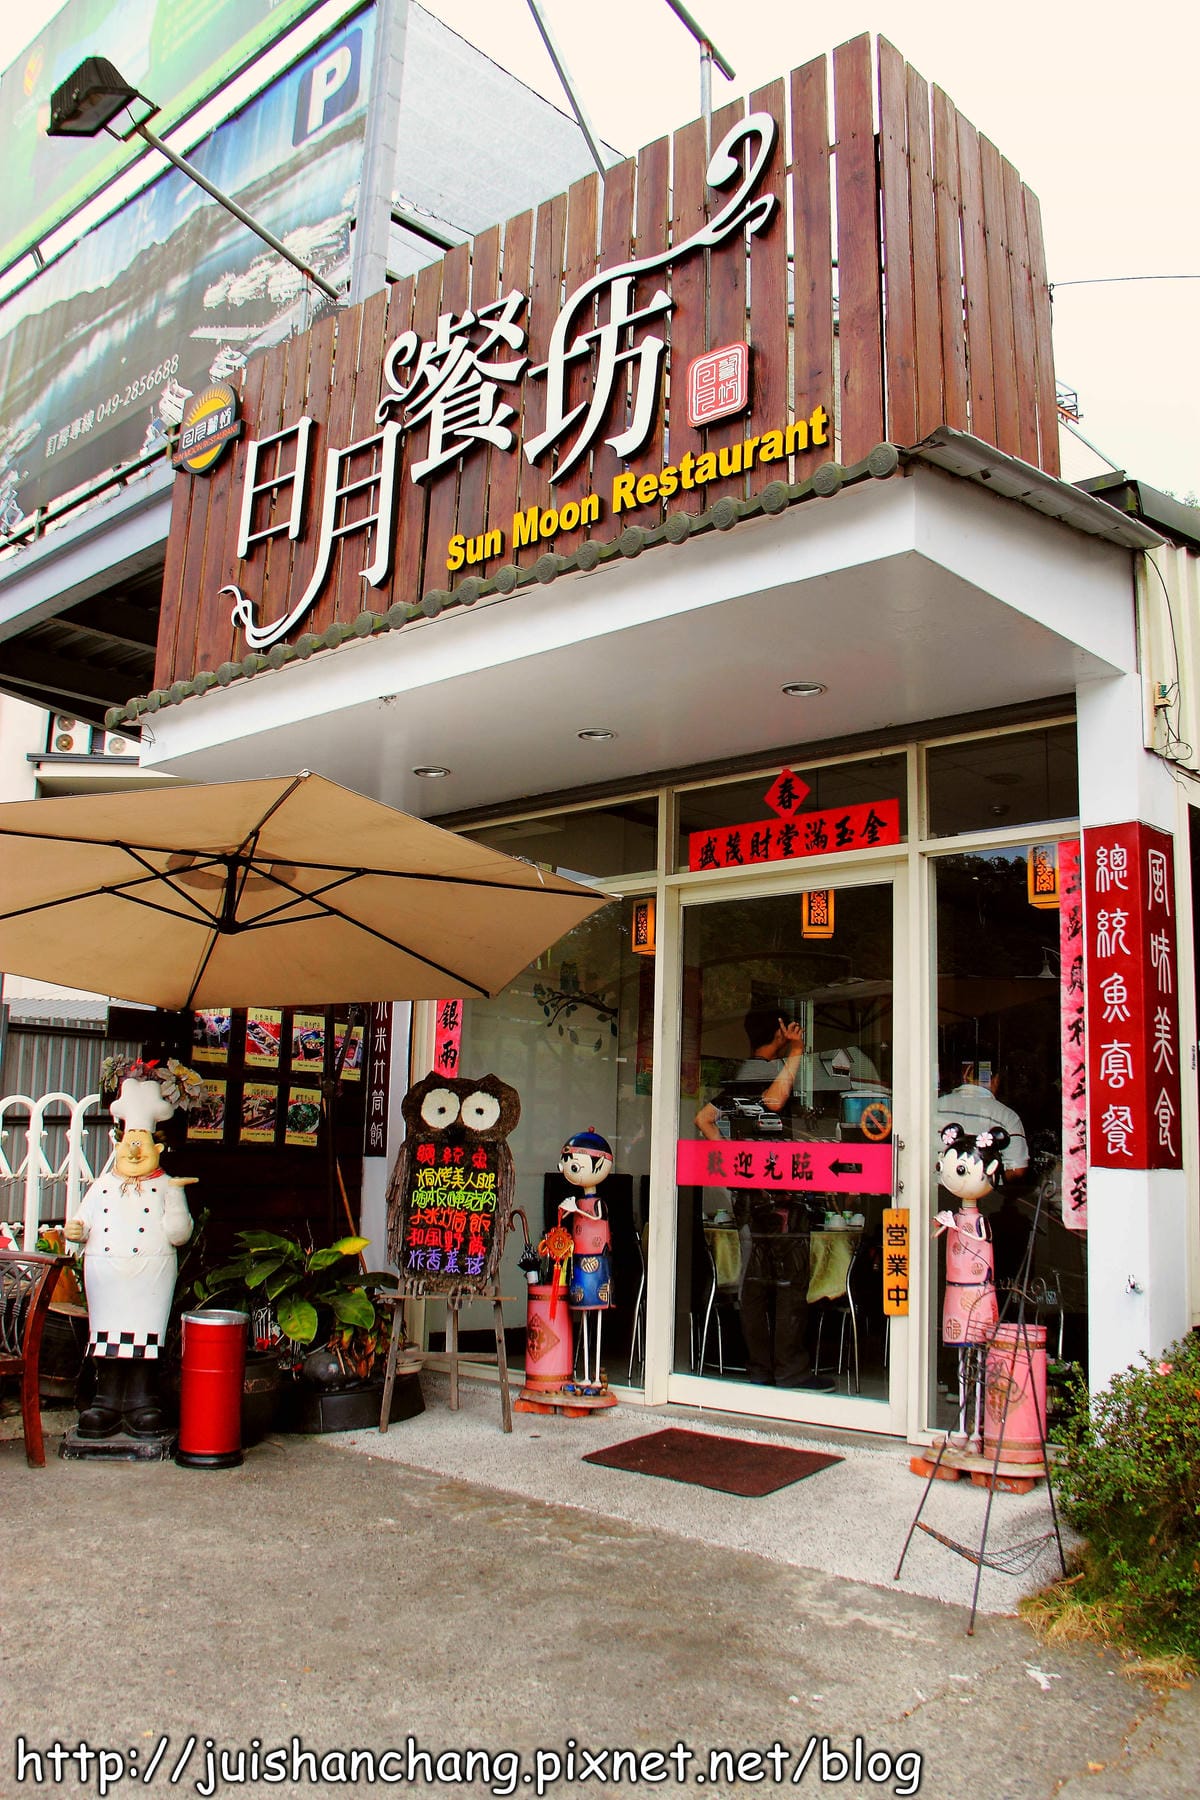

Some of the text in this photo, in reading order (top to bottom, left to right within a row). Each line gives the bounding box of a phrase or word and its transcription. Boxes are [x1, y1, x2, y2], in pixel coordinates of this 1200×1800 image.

[307, 46, 352, 135] P
[97, 353, 179, 422] 049-2856688
[446, 405, 828, 571] Sun Moon Restaurant
[776, 777, 800, 810] 春
[1095, 844, 1134, 1157] 總統魚套餐
[1147, 848, 1176, 1157] 風味美食
[706, 1150, 814, 1181] 歡迎光臨
